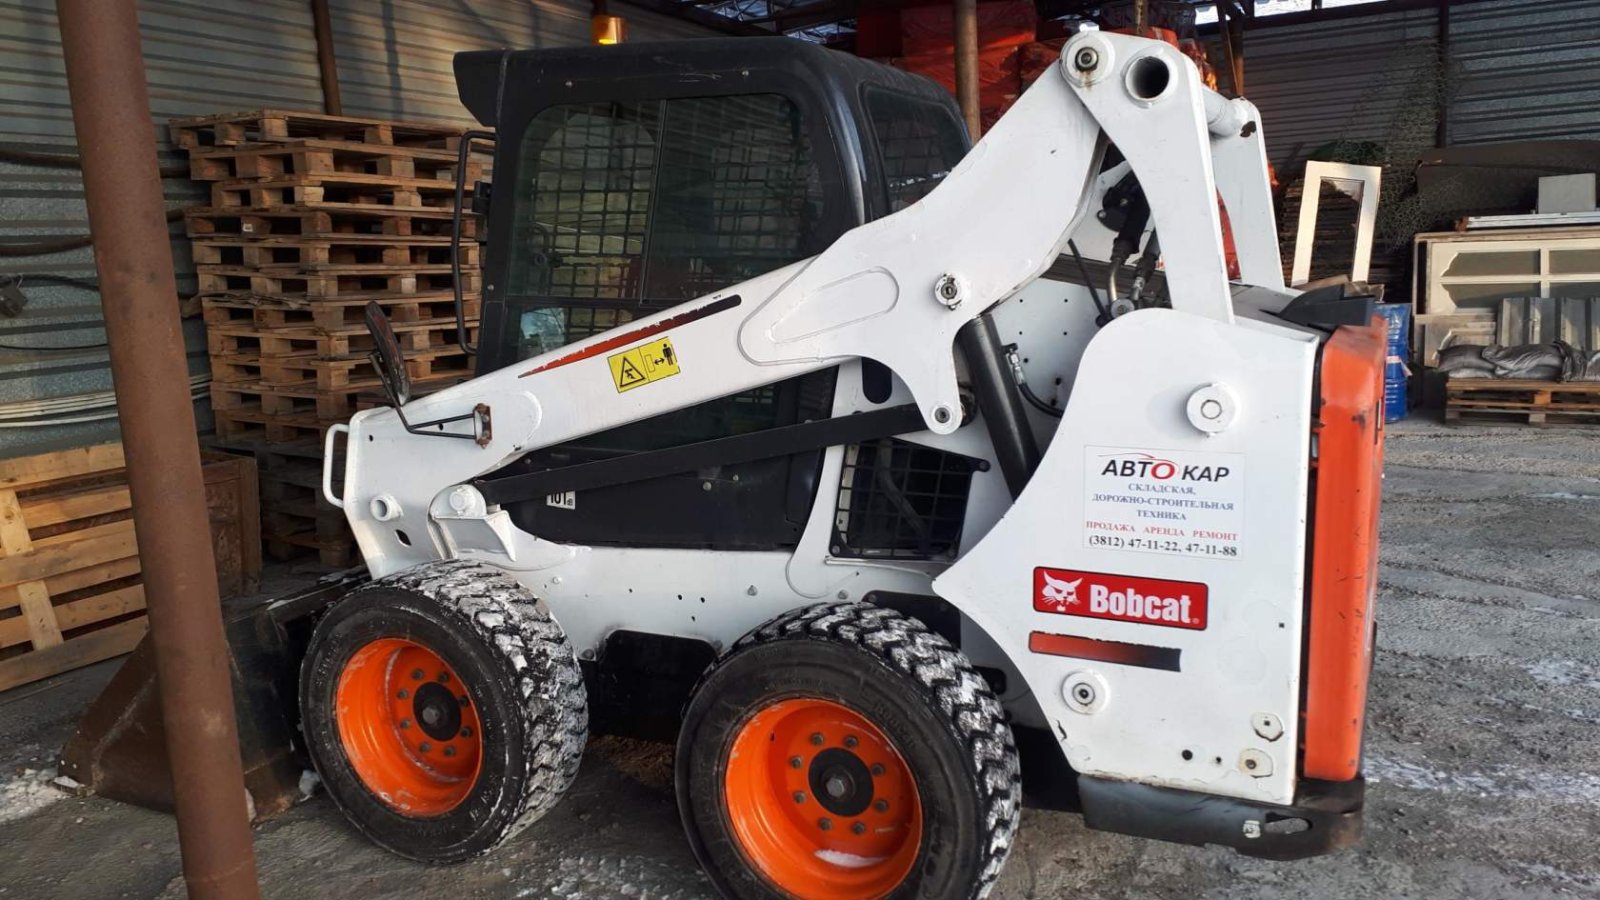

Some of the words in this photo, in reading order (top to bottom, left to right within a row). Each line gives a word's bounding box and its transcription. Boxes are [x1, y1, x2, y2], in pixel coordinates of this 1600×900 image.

[1101, 459, 1176, 480] АВТО
[1181, 465, 1230, 482] КАР
[1128, 483, 1196, 495] СКЛАДСКАЯ,
[1092, 493, 1234, 511] ДОРОЖНО-СТРОИТЕЛЬНАЯ
[1136, 509, 1187, 521] ТЕХНИКА
[1086, 520, 1136, 533] ПРОДАЖА
[1143, 526, 1185, 537] АРЕНДА
[1192, 529, 1239, 541] РЕМОНТ
[1088, 534, 1125, 549] (3812)
[1128, 538, 1182, 552] 47-11-22,
[1185, 543, 1238, 556] 47-11-88
[1089, 584, 1192, 624] Bobcat
